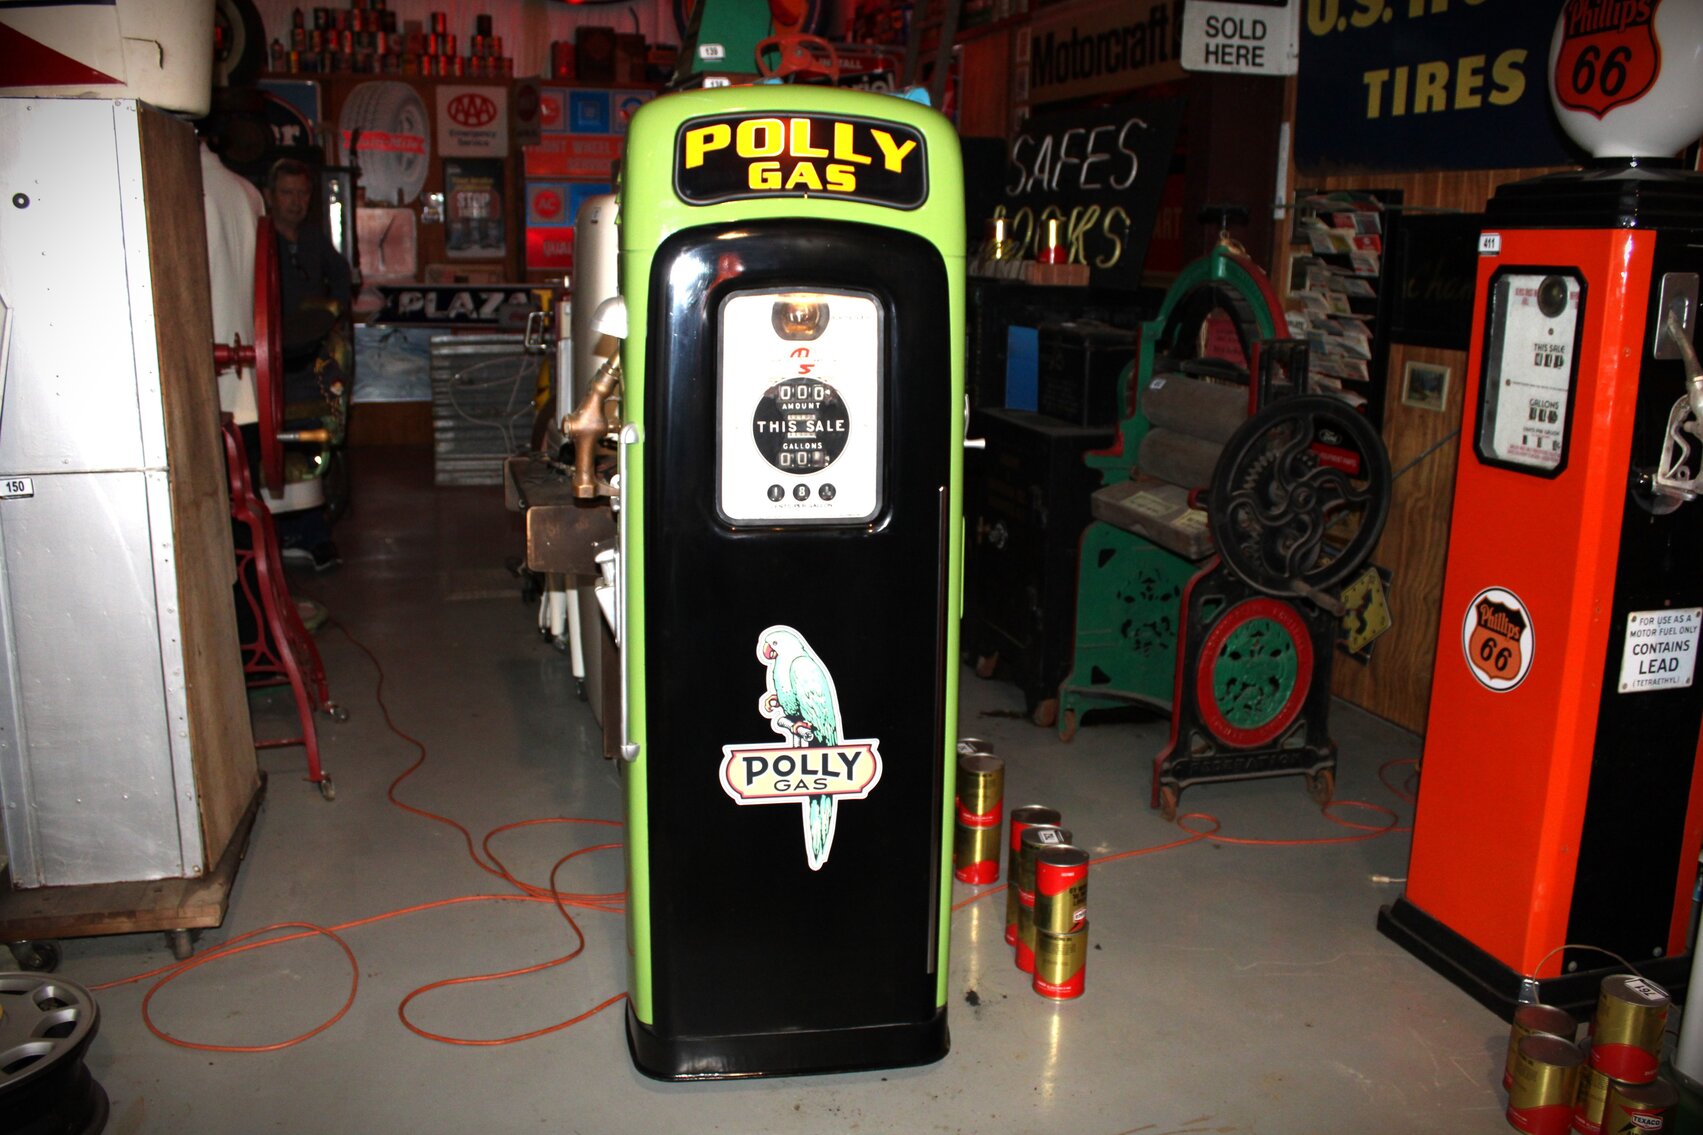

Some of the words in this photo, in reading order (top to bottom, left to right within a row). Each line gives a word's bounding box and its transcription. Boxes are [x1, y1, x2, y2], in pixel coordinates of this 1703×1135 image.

[1568, 0, 1651, 33] Phillips
[1205, 16, 1266, 40] SOLD
[1032, 10, 1169, 88] Motorcraft
[1205, 43, 1264, 67] HERE
[817, 58, 863, 70] INTALL
[1571, 45, 1632, 97] 66
[1363, 48, 1529, 119] TIRES
[448, 95, 496, 127] AAA
[685, 117, 917, 174] POLLY
[1005, 117, 1148, 197] SAFES
[748, 161, 856, 192] GAS
[1484, 237, 1495, 249] 411
[782, 402, 821, 410] AMOUNT
[1529, 398, 1560, 410] GALLONS
[757, 420, 797, 433] THIS
[806, 419, 845, 432] SALE
[782, 442, 823, 450] GALLONS
[6, 480, 25, 493] 150
[1480, 604, 1520, 640] Phillips
[1639, 617, 1655, 626] FOR
[1657, 616, 1672, 625] USE
[1673, 614, 1684, 624] AS
[1685, 614, 1692, 622] A
[1630, 628, 1657, 638] MOTOR
[1659, 626, 1678, 636] FUEL
[1679, 625, 1698, 635] ONLY
[1480, 637, 1513, 672] 66
[1632, 640, 1690, 656] CONTAINS
[1638, 657, 1679, 675] LEAD
[742, 751, 862, 786] POLLY
[773, 778, 828, 792] GAS
[1633, 1115, 1661, 1128] TEXACO
